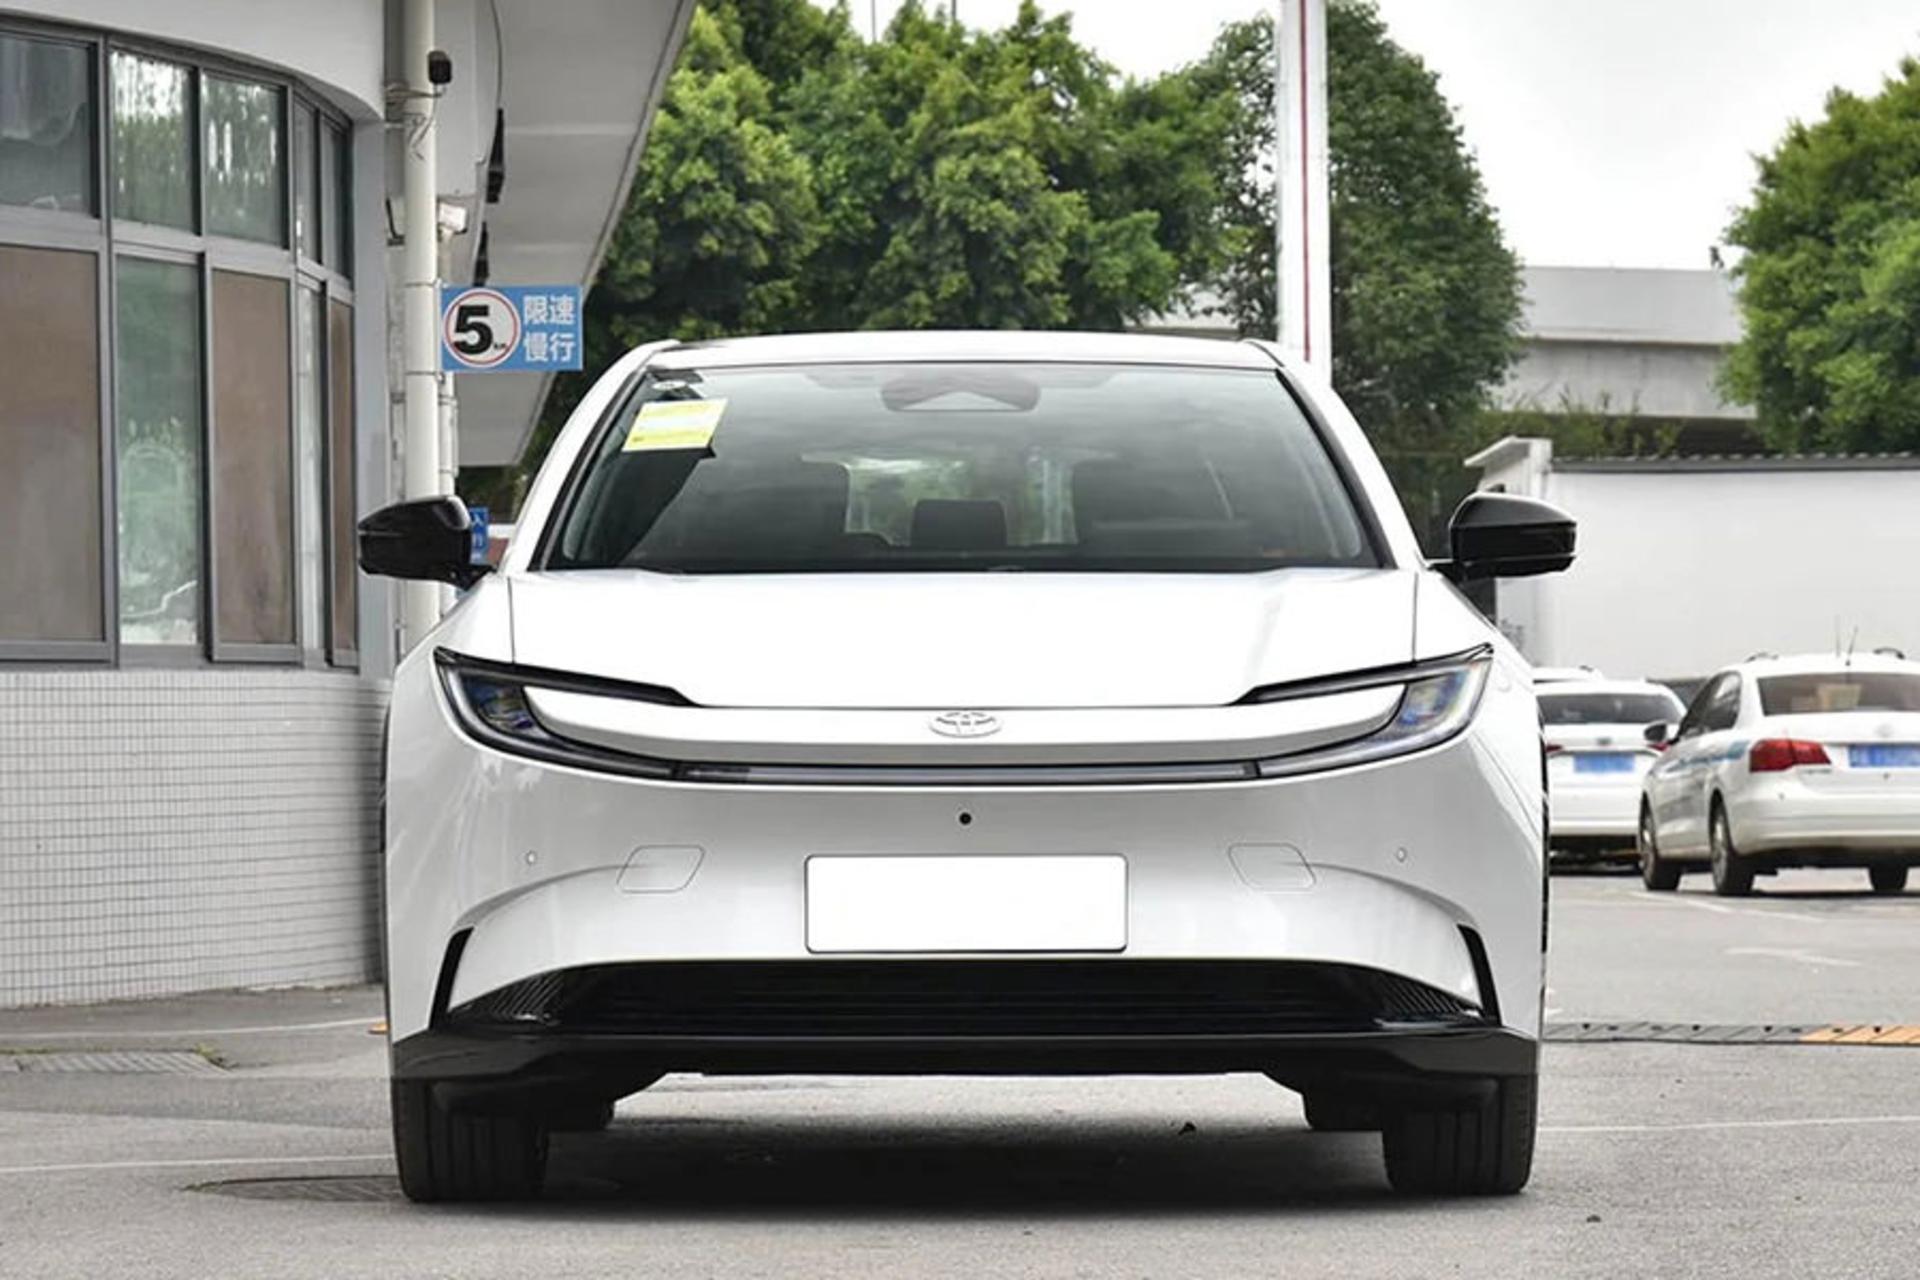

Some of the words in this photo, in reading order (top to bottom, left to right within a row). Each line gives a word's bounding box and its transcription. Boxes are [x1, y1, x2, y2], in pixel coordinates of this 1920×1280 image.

[523, 294, 575, 325] 限速
[454, 304, 493, 355] 5
[523, 331, 575, 363] 慢行
